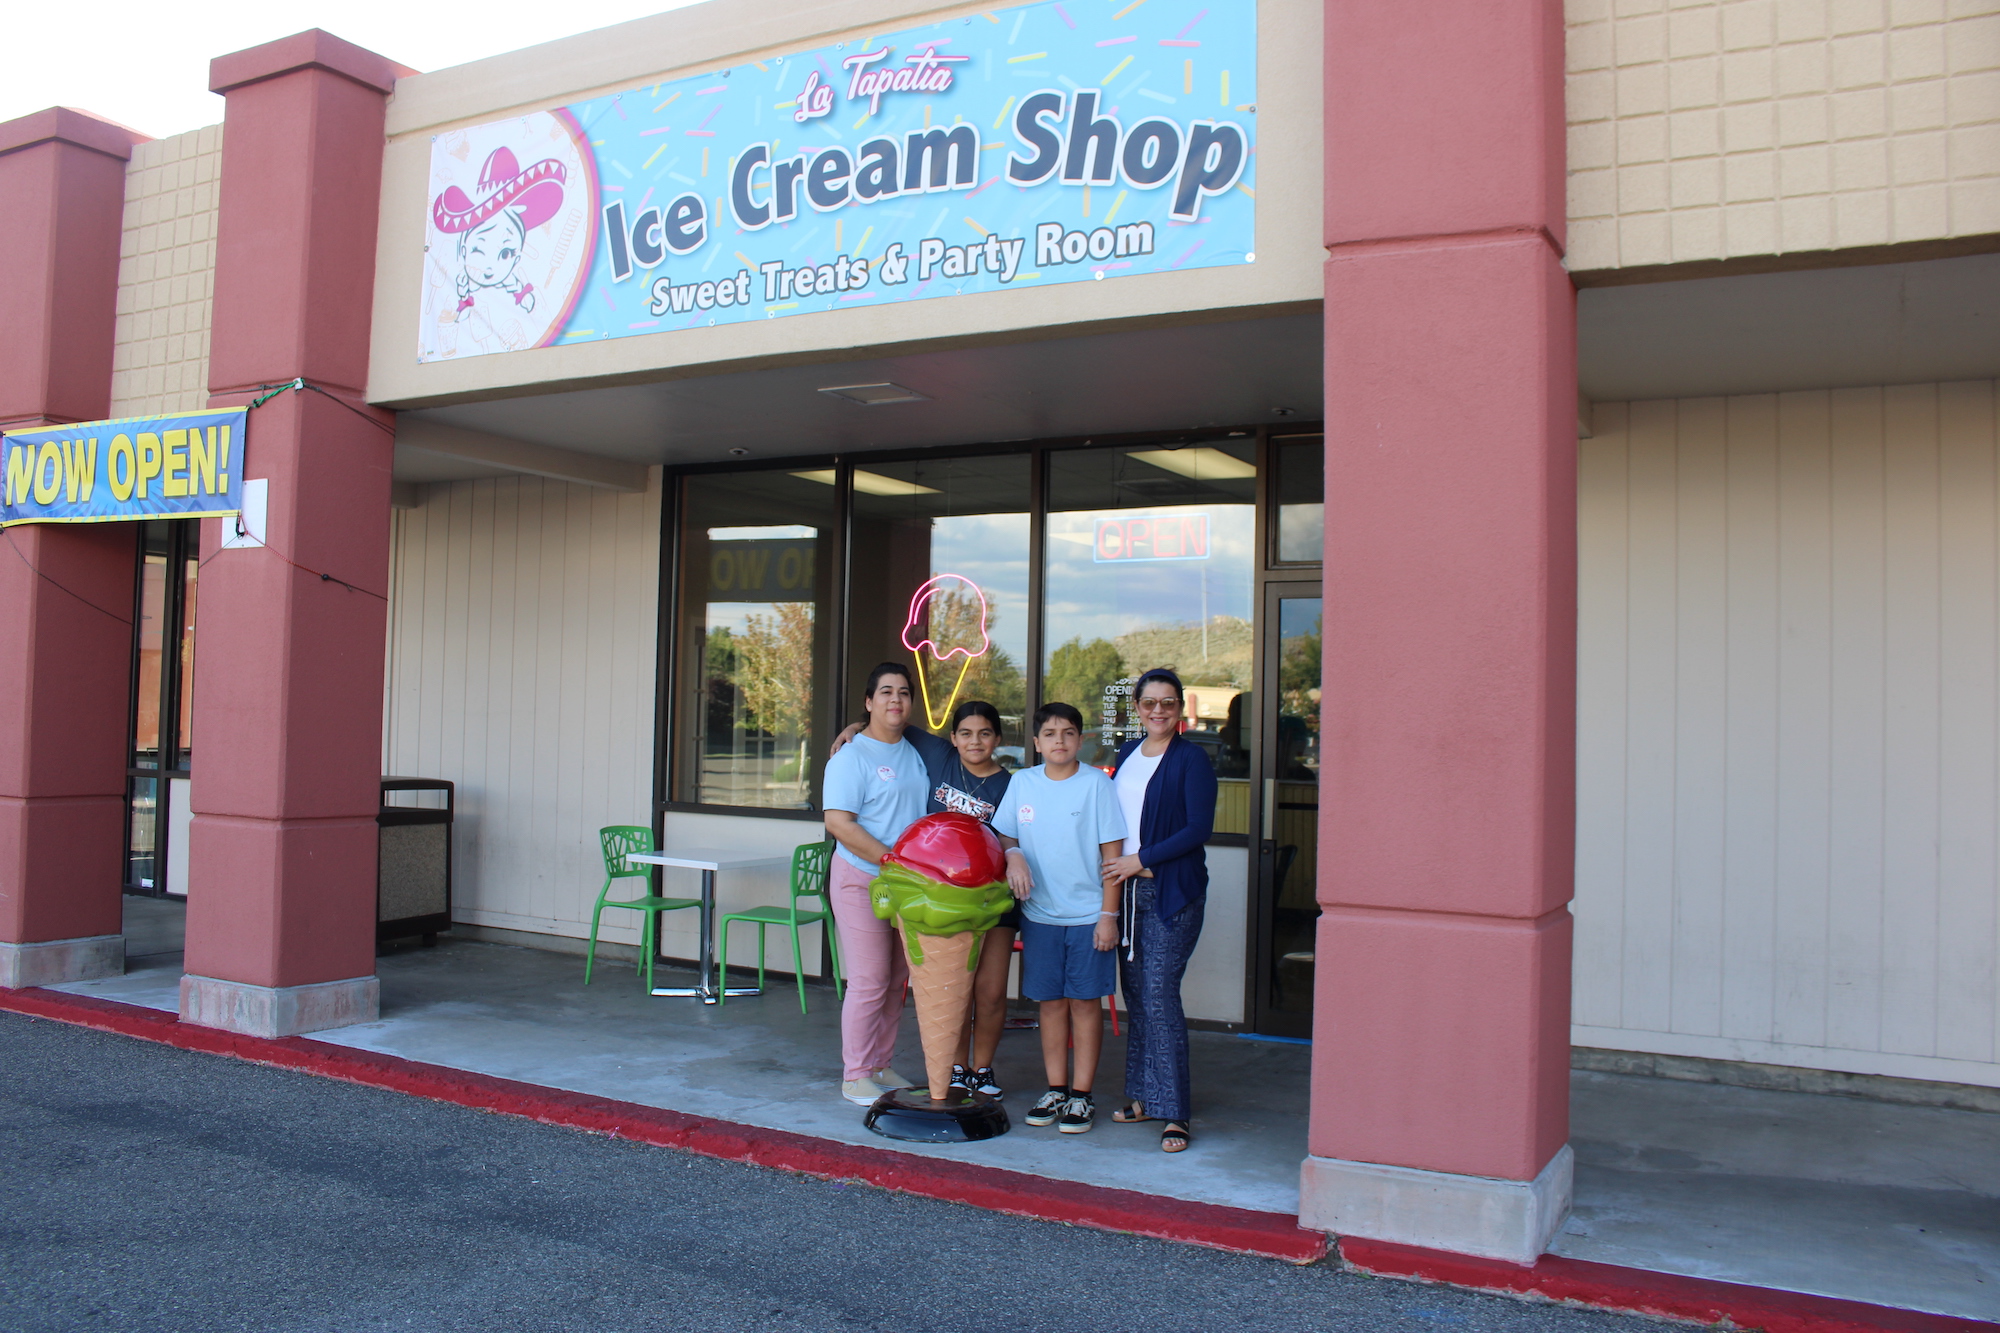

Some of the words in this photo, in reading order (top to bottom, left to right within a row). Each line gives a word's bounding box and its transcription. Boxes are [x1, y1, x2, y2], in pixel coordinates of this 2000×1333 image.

[794, 70, 834, 122] La
[604, 192, 708, 283] Ice
[729, 120, 980, 231] Cream
[1006, 88, 1250, 221] Shop
[651, 269, 750, 316] Sweet
[760, 254, 869, 301] Treats
[880, 243, 908, 285] &
[918, 234, 1025, 283] Party
[1035, 221, 1154, 267] Room
[6, 437, 98, 507] NOW
[107, 425, 231, 502] OPEN!
[1098, 516, 1206, 559] OPEN
[709, 548, 771, 592] OW
[945, 788, 983, 816] VANS
